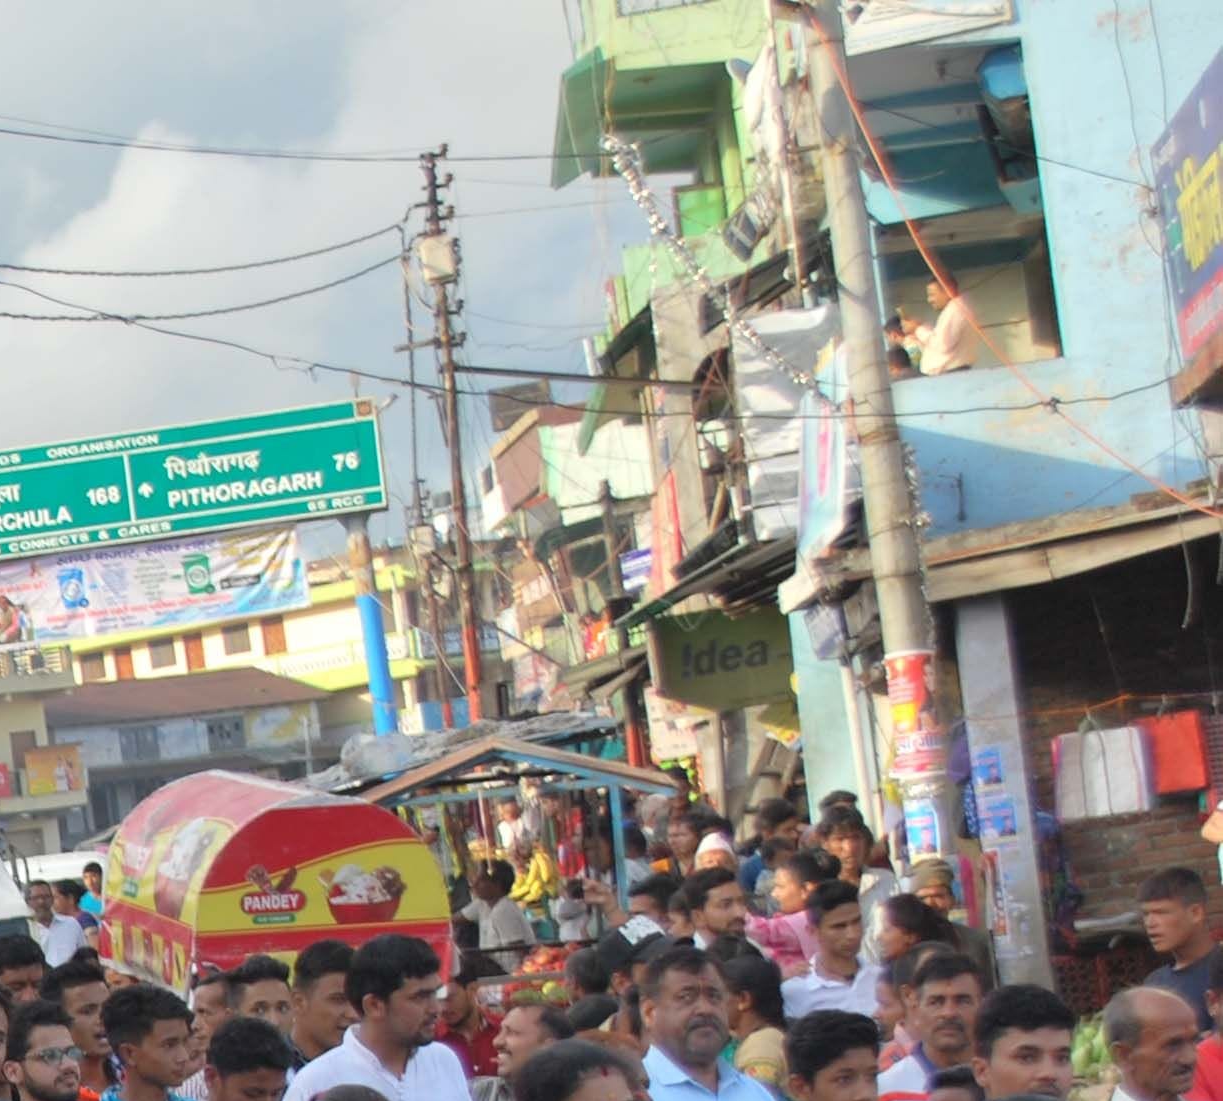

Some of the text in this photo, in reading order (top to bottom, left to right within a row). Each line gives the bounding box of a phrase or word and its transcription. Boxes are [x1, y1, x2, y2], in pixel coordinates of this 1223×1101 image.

[46, 434, 159, 459] ORGANISATION
[333, 452, 359, 472] 76
[86, 485, 120, 506] 168
[168, 471, 323, 508] PITHORAGARH
[8, 531, 90, 553] CONNECTS
[98, 528, 110, 541] &
[118, 521, 172, 538] CARES
[332, 495, 364, 508] RCC
[243, 894, 299, 911] PANDEY
